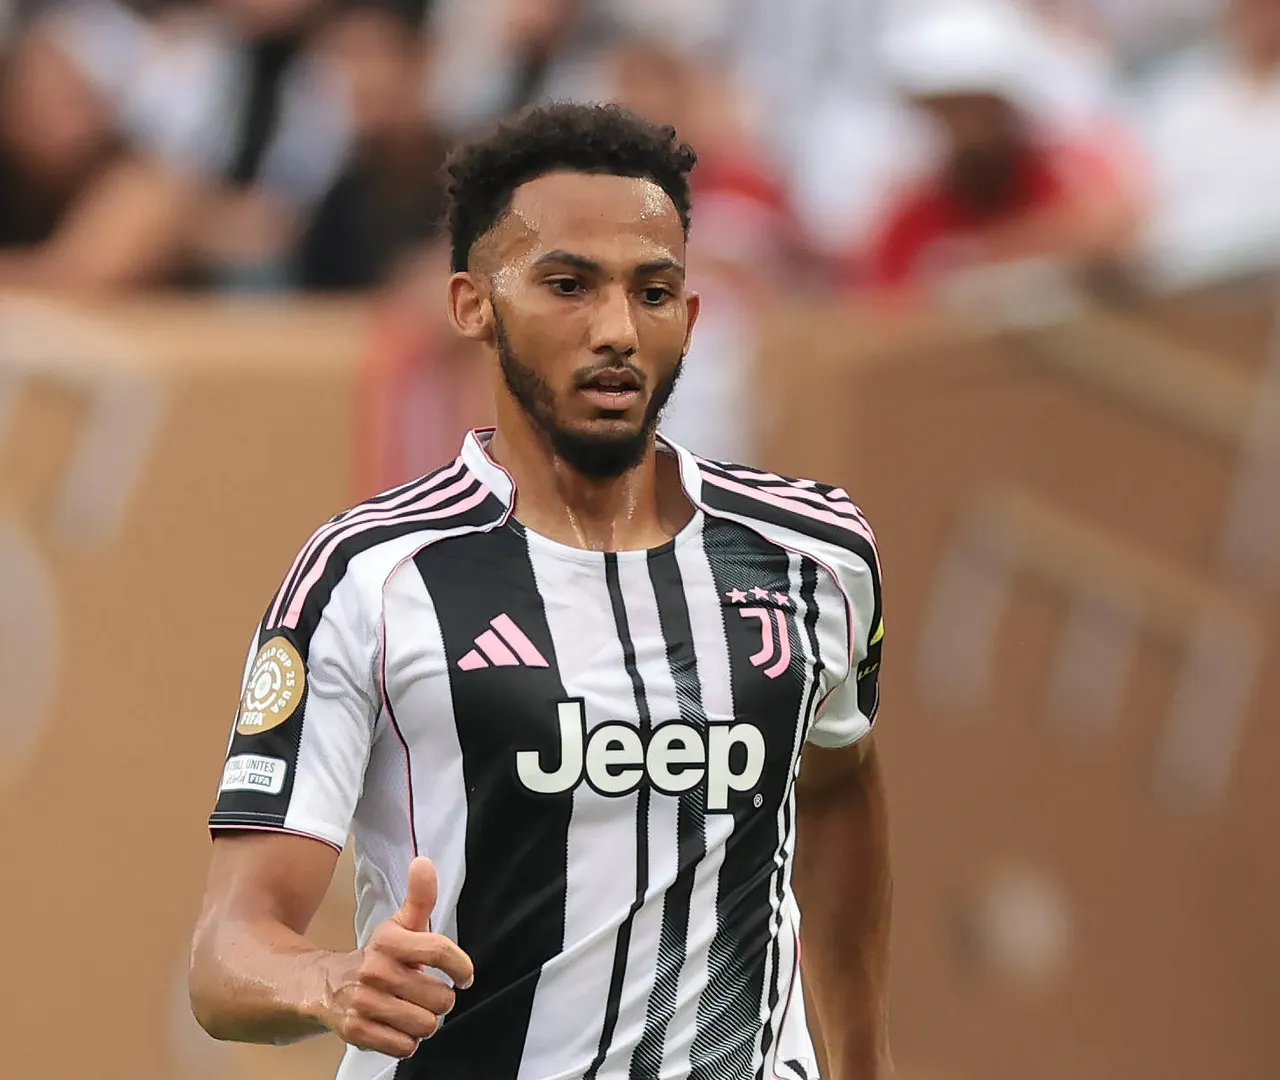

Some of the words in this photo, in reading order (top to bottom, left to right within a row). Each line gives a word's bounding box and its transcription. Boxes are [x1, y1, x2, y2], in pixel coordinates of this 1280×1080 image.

[276, 648, 293, 668] CUP
[286, 671, 296, 687] 25
[270, 690, 293, 714] USA
[240, 711, 265, 726] FIFA
[515, 700, 767, 811] Jeep
[245, 758, 276, 774] UNITES
